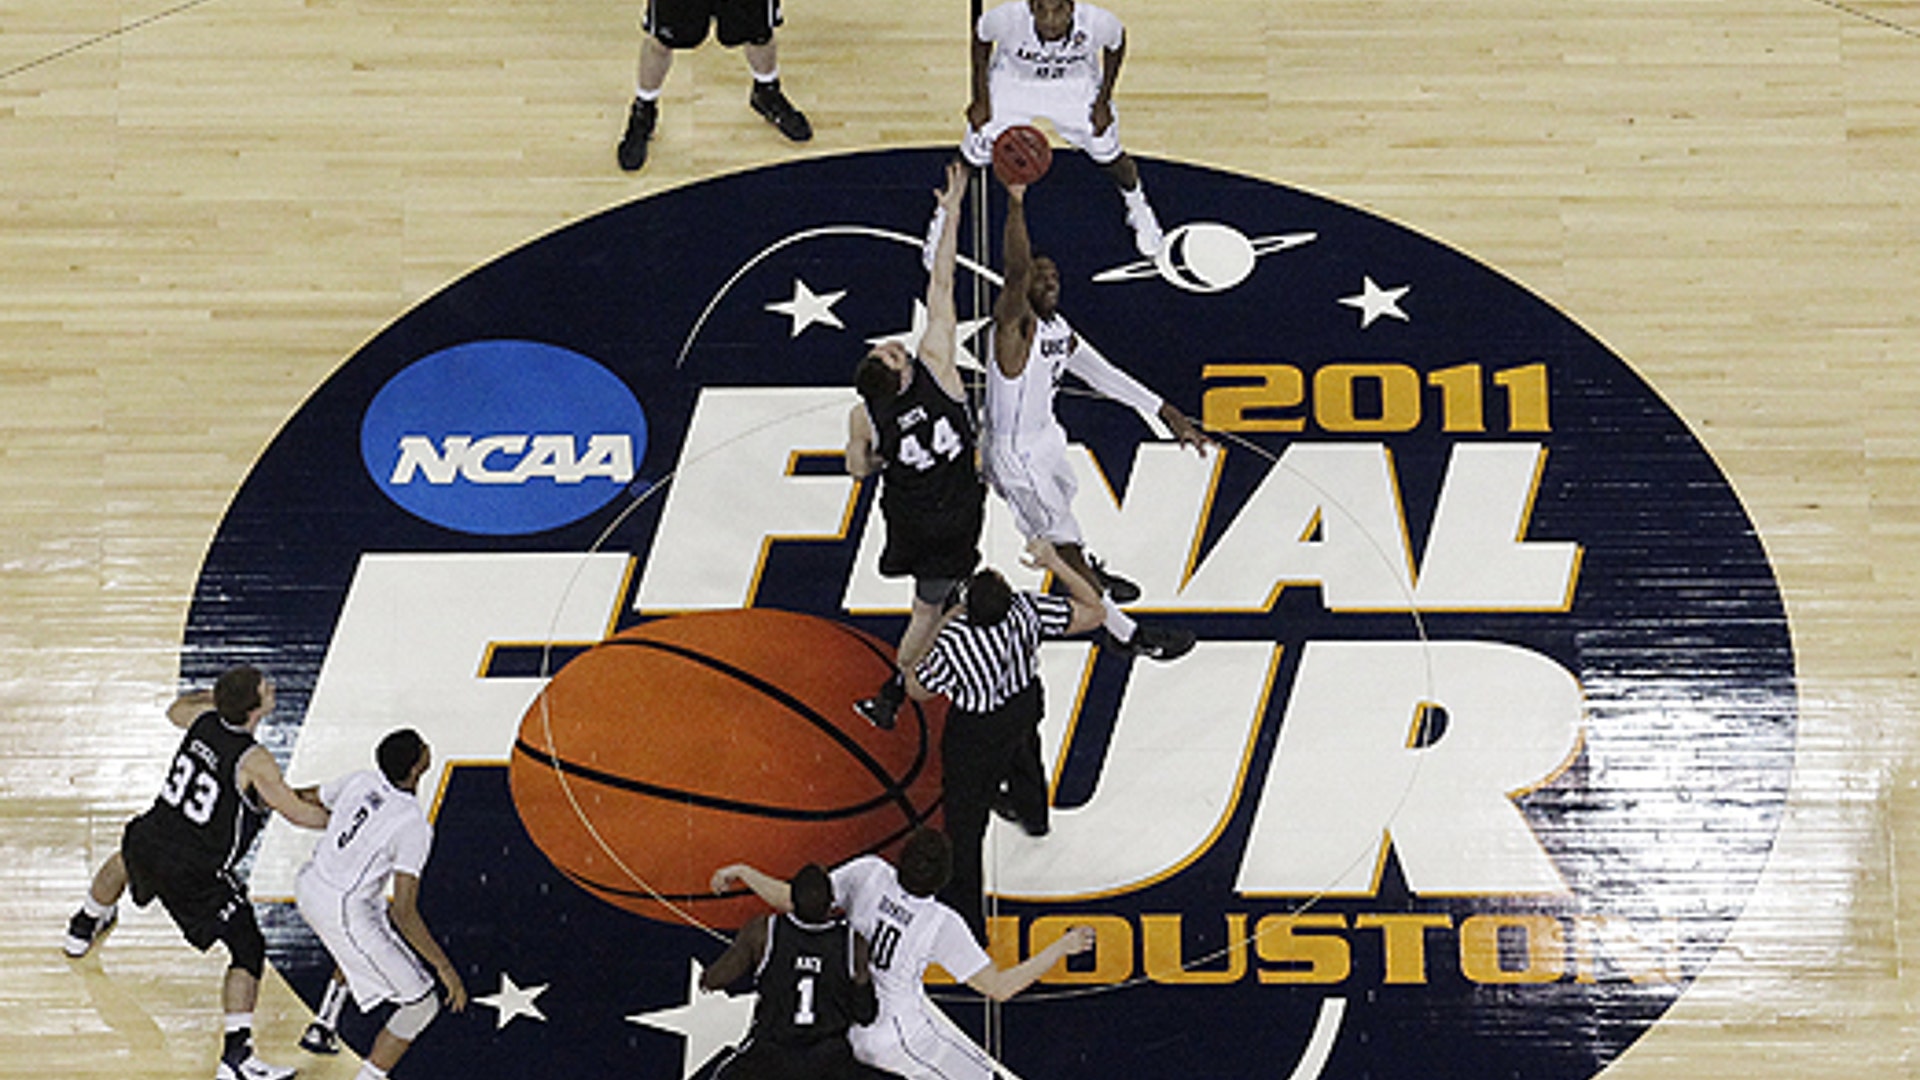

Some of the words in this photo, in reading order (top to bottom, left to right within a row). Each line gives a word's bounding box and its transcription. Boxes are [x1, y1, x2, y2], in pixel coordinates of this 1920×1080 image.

[1202, 363, 1552, 434] 2011
[389, 433, 635, 484] NCAA
[898, 416, 962, 472] 44
[160, 754, 219, 824] 33
[337, 805, 369, 849] 3
[867, 919, 901, 971] 10
[793, 976, 816, 1025] 1
